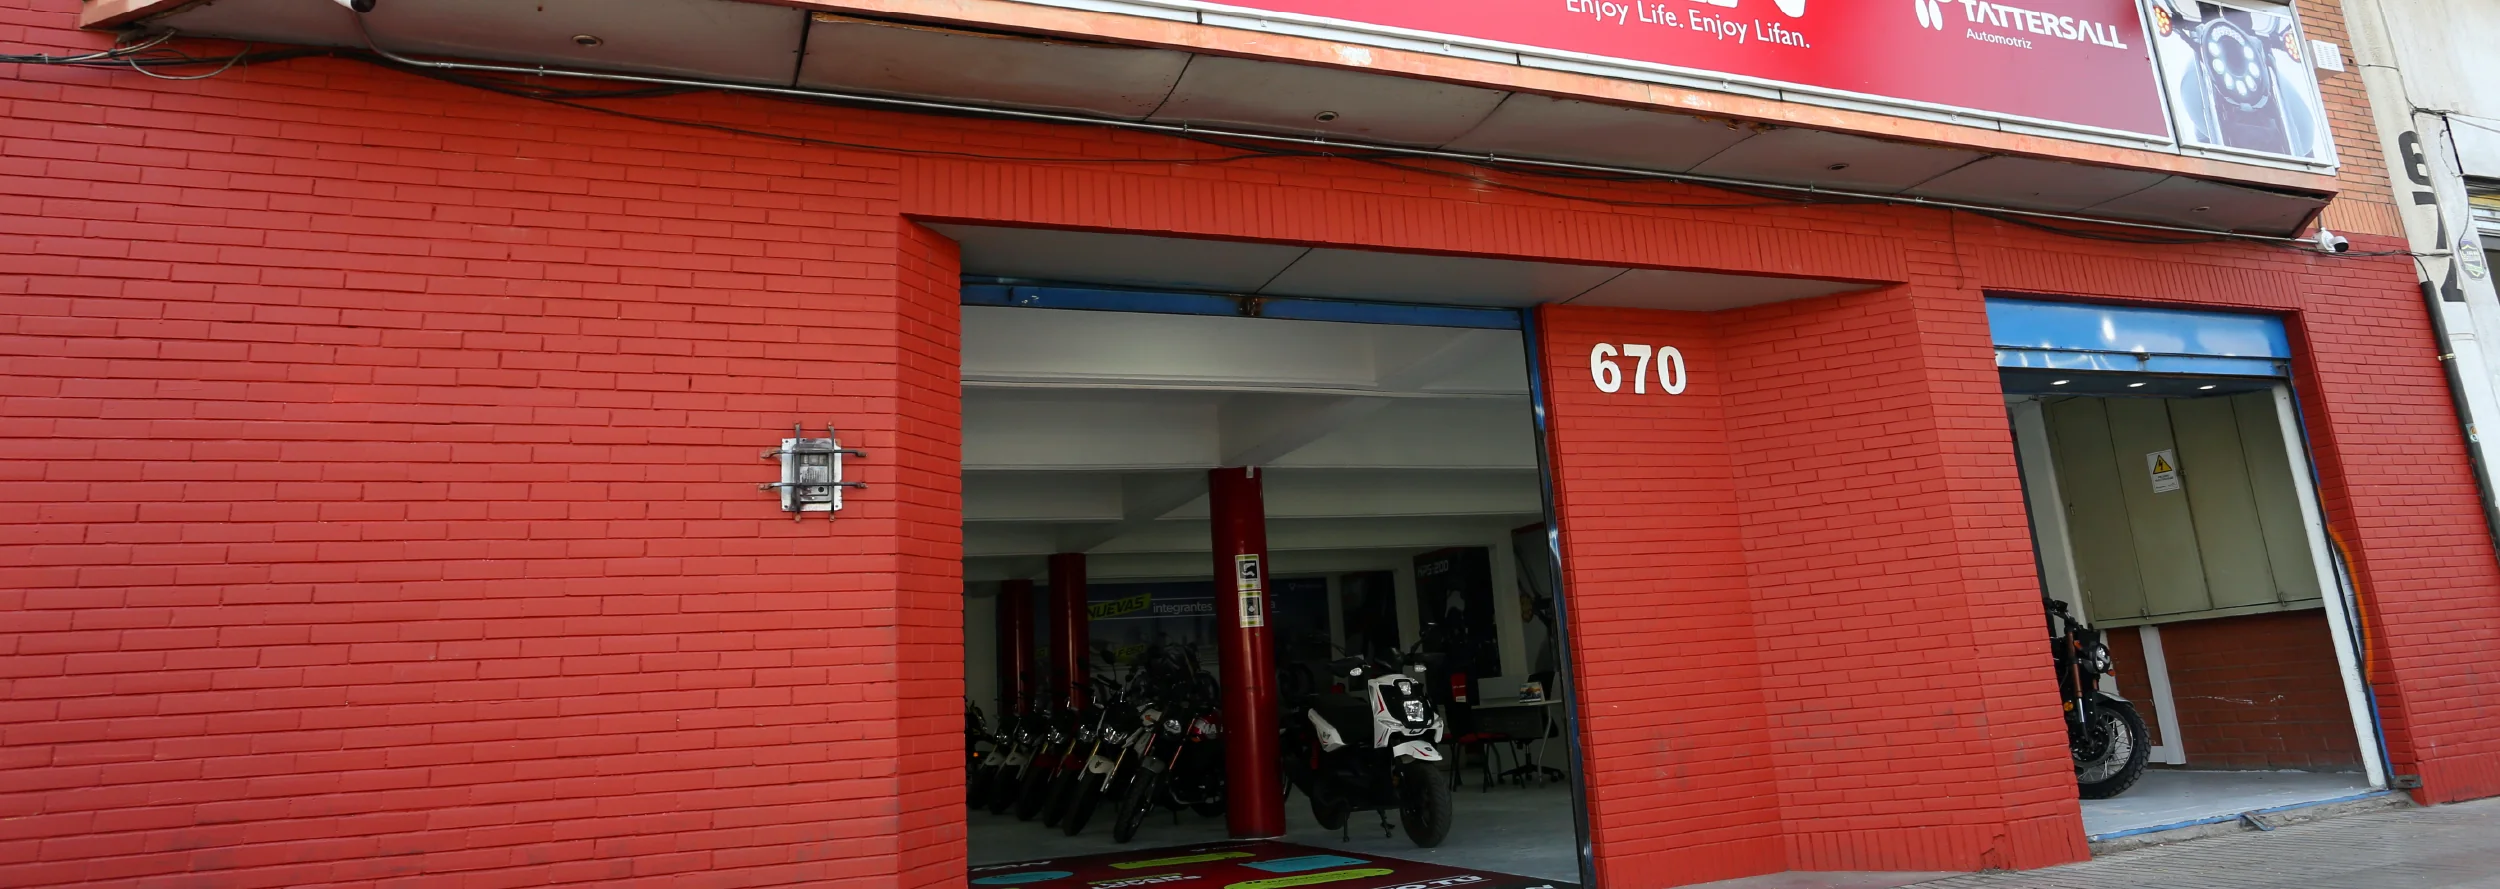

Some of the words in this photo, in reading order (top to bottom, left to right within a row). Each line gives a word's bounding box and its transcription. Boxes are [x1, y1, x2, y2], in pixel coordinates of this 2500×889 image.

[1566, 0, 1628, 25] Enjoy
[1637, 0, 1684, 28] Life.
[1688, 9, 1748, 44] Enjoy
[1754, 19, 1811, 48] Lifan.
[1957, 0, 2128, 49] TATTERSALL
[1966, 28, 2033, 49] Automotriz
[1590, 342, 1687, 395] 670
[1088, 596, 1144, 618] NUEVAS
[1152, 602, 1213, 615] integrantes
